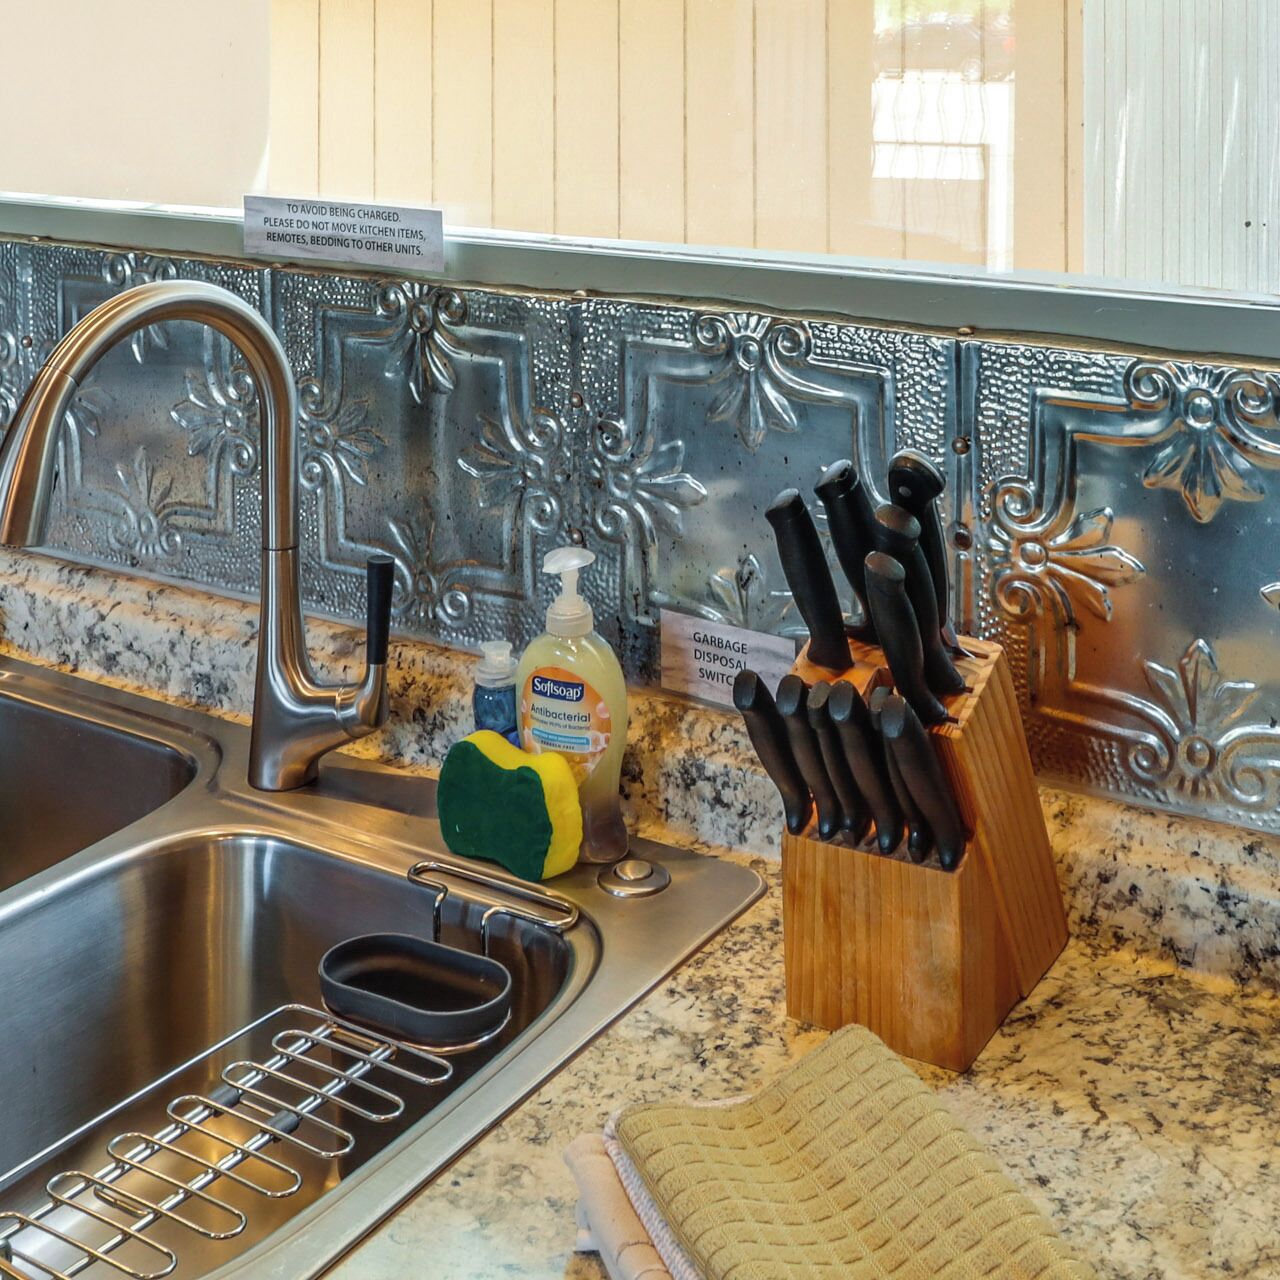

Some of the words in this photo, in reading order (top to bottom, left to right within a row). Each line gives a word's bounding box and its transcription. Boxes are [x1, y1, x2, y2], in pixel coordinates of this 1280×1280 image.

[287, 203, 299, 214] TO
[300, 204, 327, 216] AVOID
[329, 207, 356, 218] BEING
[357, 209, 402, 222] CHARGED.
[263, 216, 294, 228] PLEASE
[296, 219, 310, 229] DO
[312, 221, 329, 231] NOT
[331, 222, 358, 234] MOVE
[359, 225, 396, 237] KITCHEN
[397, 228, 426, 242] ITEMS,
[266, 231, 309, 246] REMOTES,
[310, 235, 350, 249] BEDDING
[351, 239, 363, 250] TO
[365, 240, 393, 253] OTHER
[395, 243, 424, 256] UNITS.
[693, 631, 748, 655] GARBAGE
[698, 667, 735, 686] SWITC
[534, 678, 581, 701] Softsoap
[531, 704, 591, 722] Antibacterial
